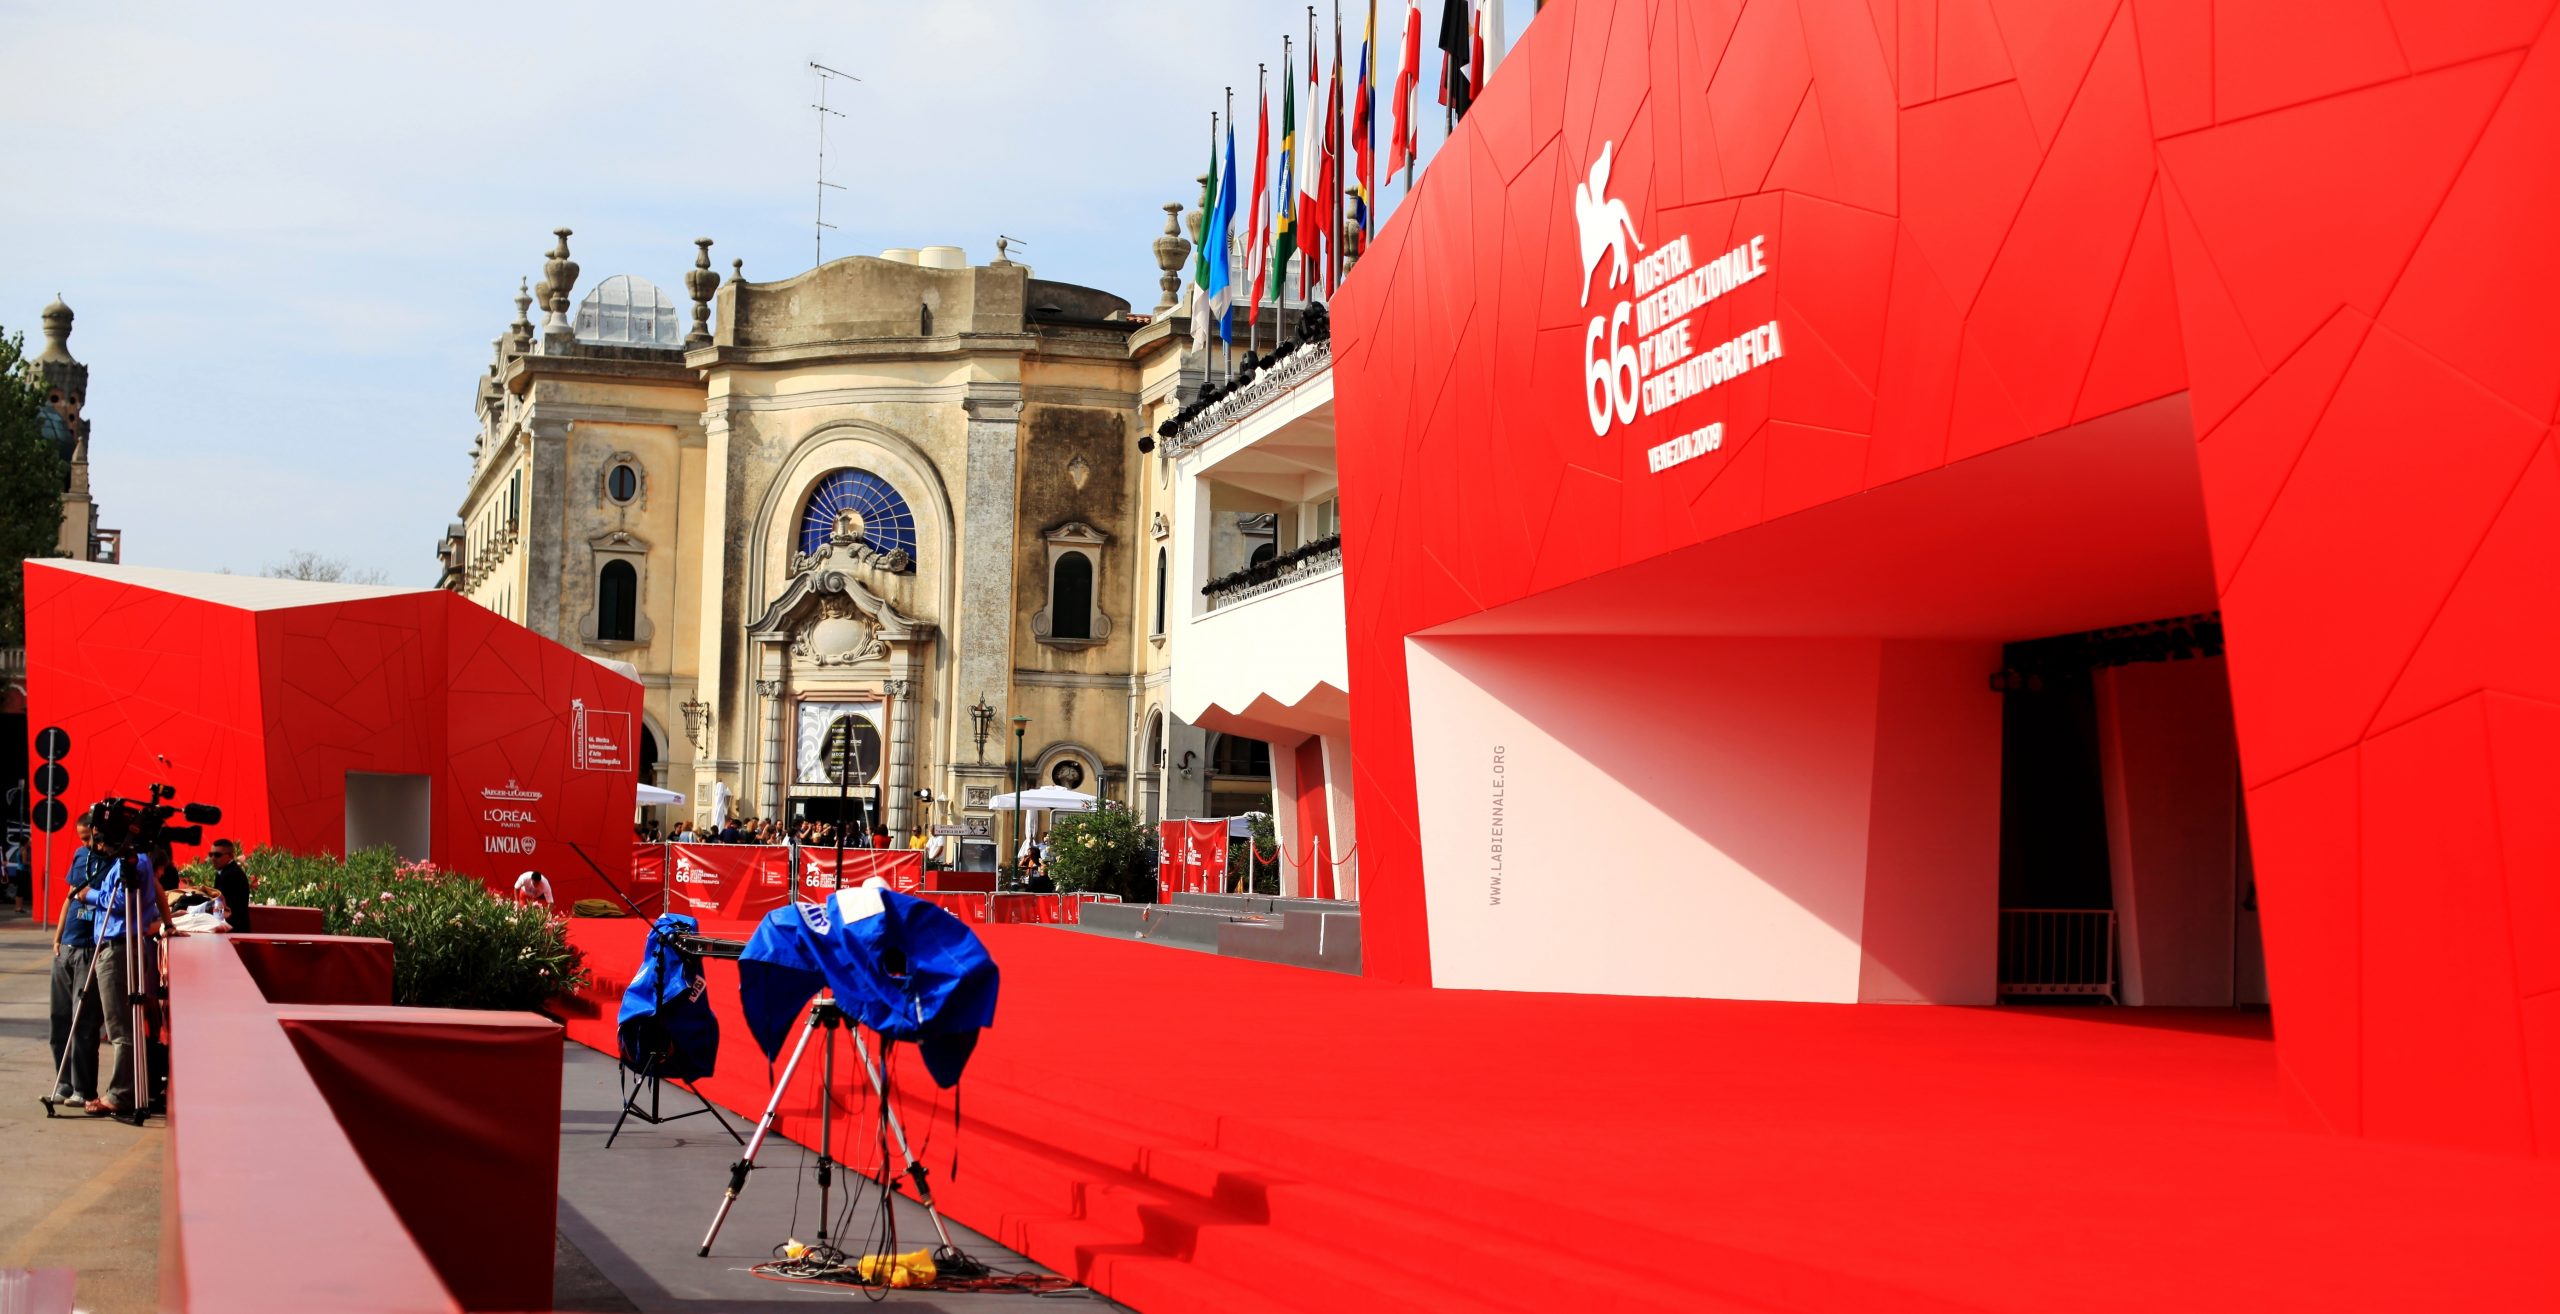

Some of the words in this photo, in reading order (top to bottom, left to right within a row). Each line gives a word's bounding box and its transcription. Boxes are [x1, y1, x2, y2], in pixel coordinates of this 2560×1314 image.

[1633, 235, 1692, 298] MOSTRA
[1636, 235, 1767, 338] INTERNAZIONALE
[1585, 300, 1639, 436] 66
[1639, 319, 1693, 377] D'ARTE
[1642, 321, 1784, 416] CINEMATOGRAFICA
[1648, 433, 1692, 474] VENEZIA
[1691, 422, 1724, 458] 2009
[485, 836, 521, 853] LANCIA
[1489, 745, 1505, 906] WWW.LABIENNALE.ORG
[676, 870, 690, 882] 66
[806, 875, 820, 887] 66
